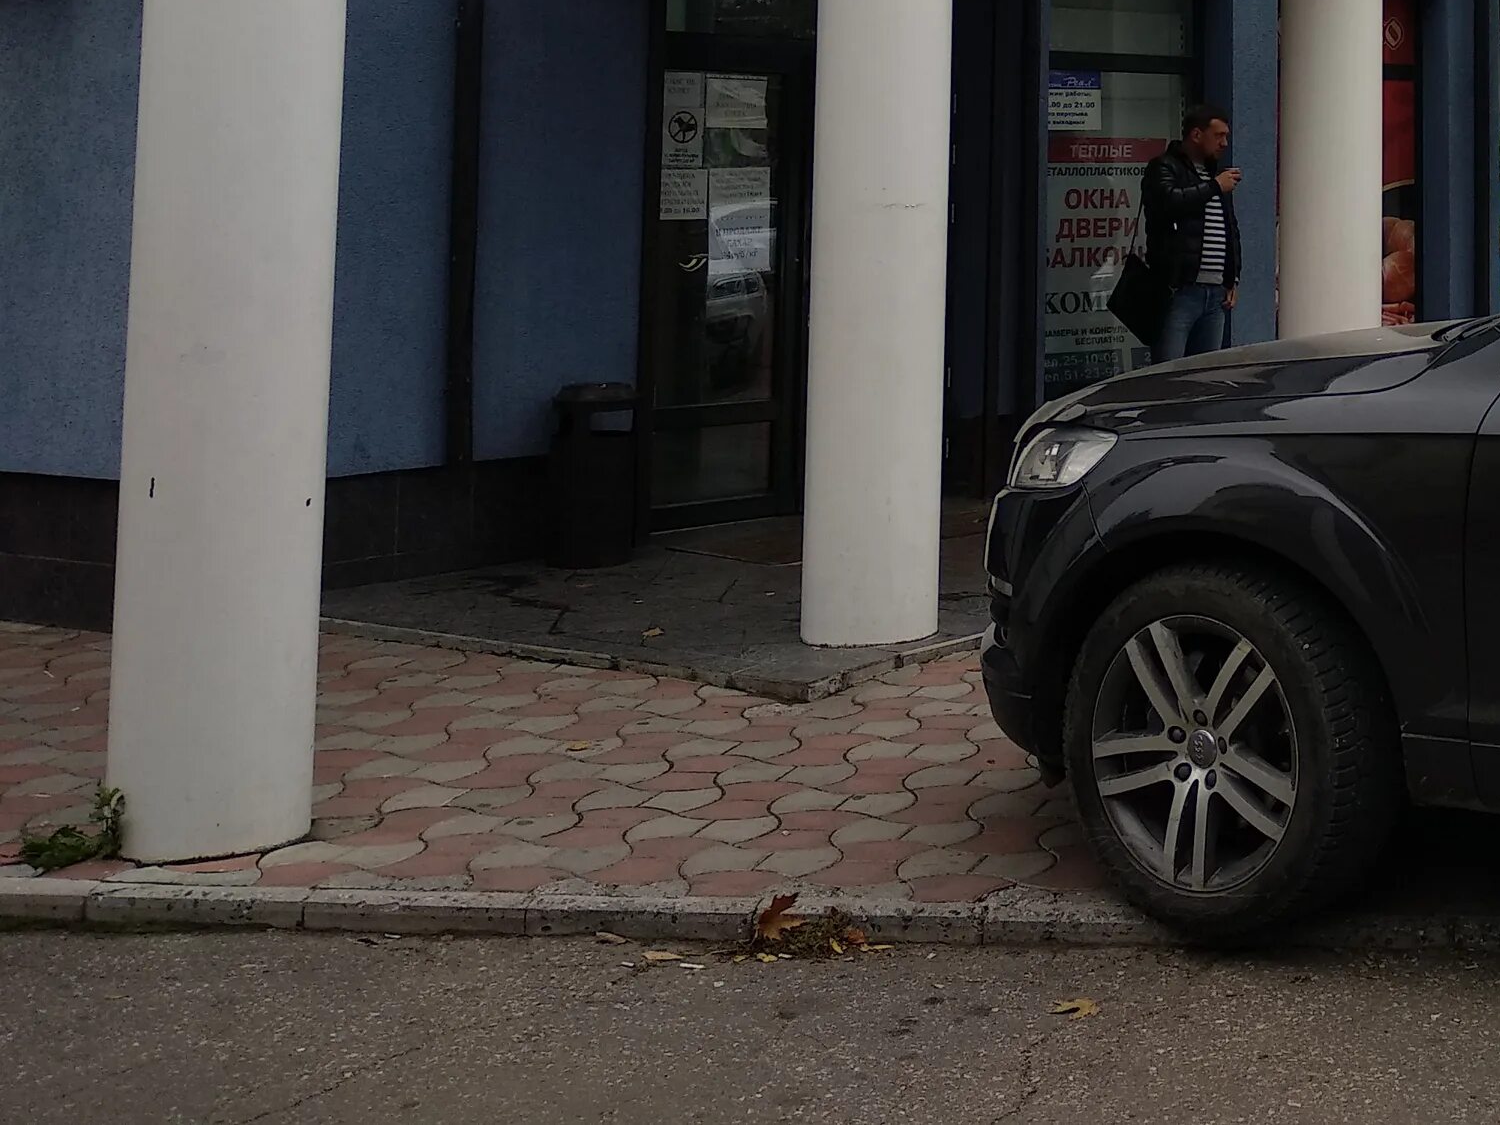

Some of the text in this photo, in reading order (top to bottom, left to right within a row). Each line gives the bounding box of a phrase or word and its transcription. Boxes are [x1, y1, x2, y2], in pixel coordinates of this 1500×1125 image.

[1069, 144, 1134, 158] ТЕПЛЫЕ
[1064, 188, 1131, 210] ОКНА
[1055, 217, 1139, 243] ДВЕРИ
